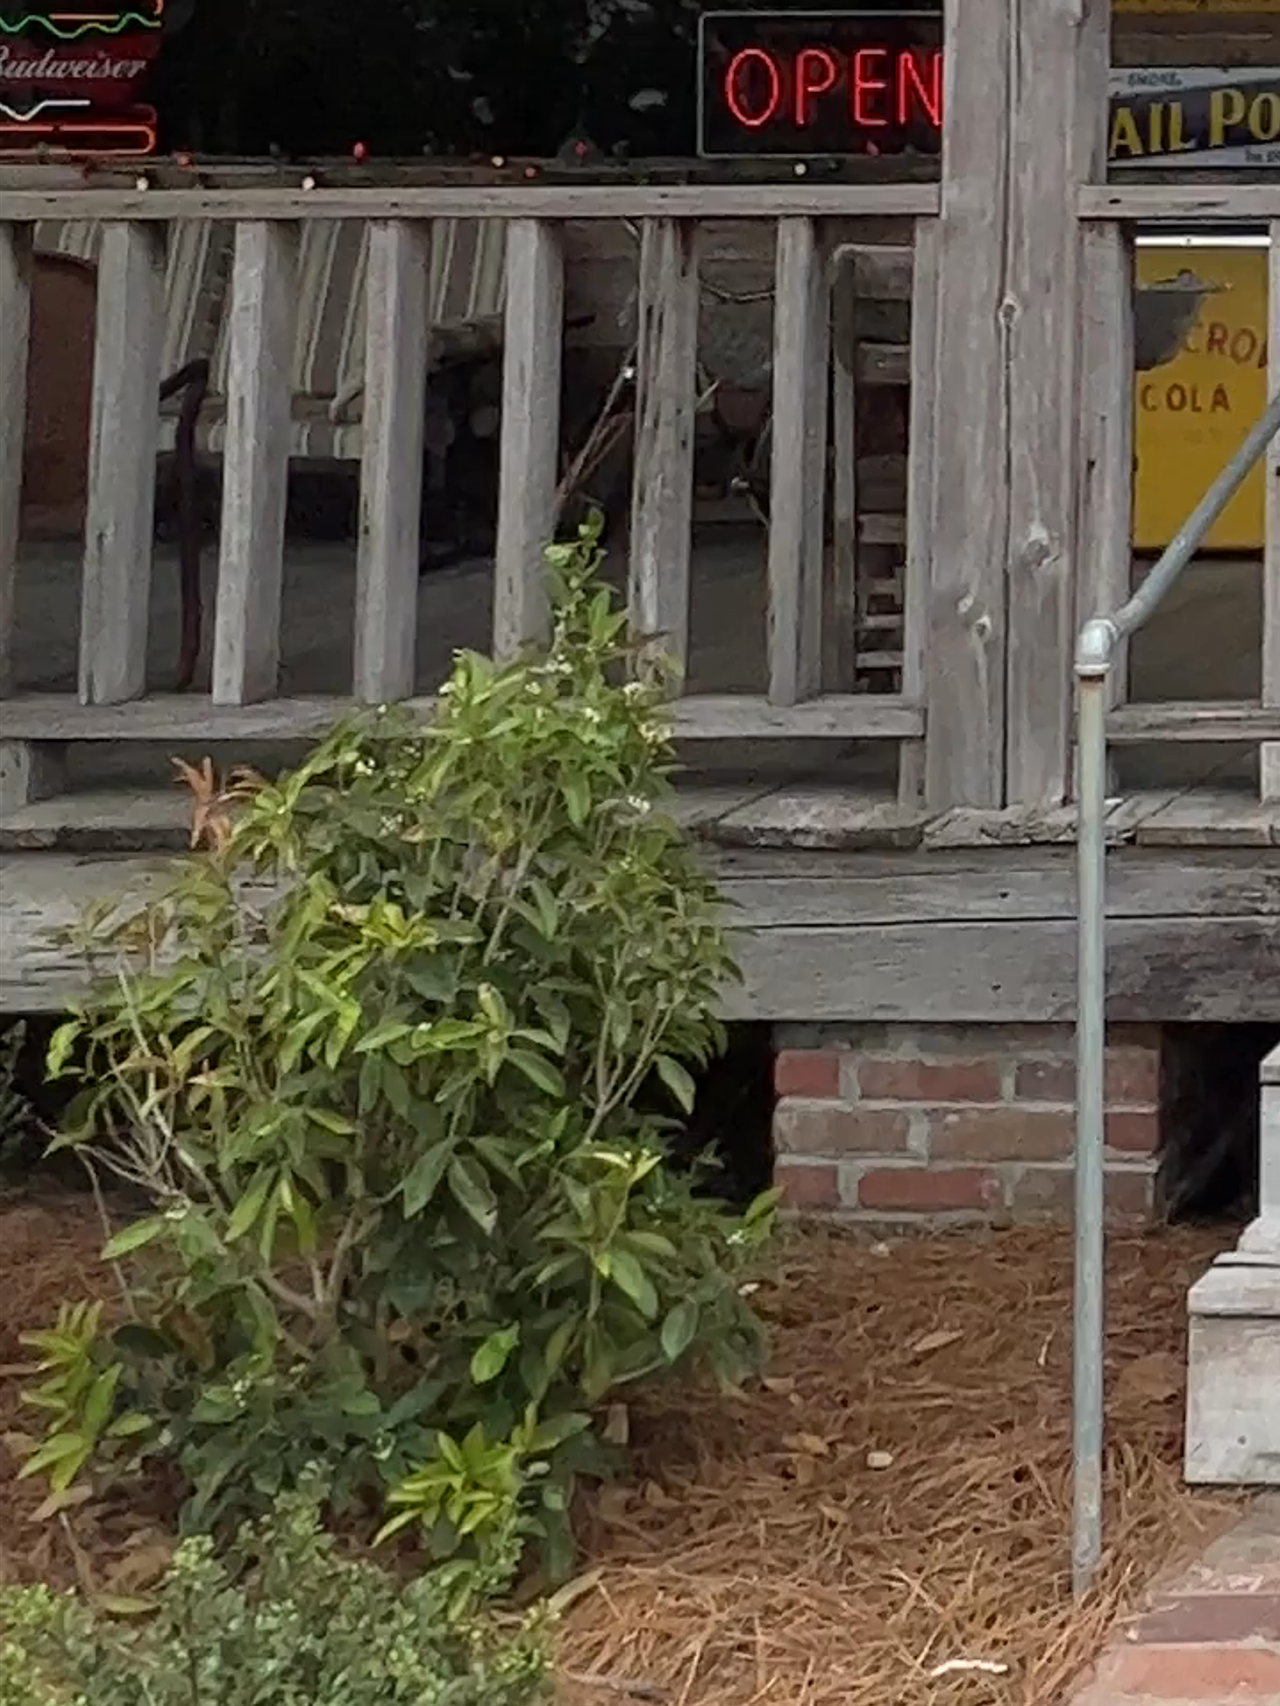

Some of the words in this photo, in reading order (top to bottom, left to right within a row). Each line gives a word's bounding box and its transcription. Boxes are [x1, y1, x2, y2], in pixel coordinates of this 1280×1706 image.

[724, 46, 942, 128] OPEN
[1108, 100, 1198, 158] AIL
[1141, 383, 1232, 413] COLA
